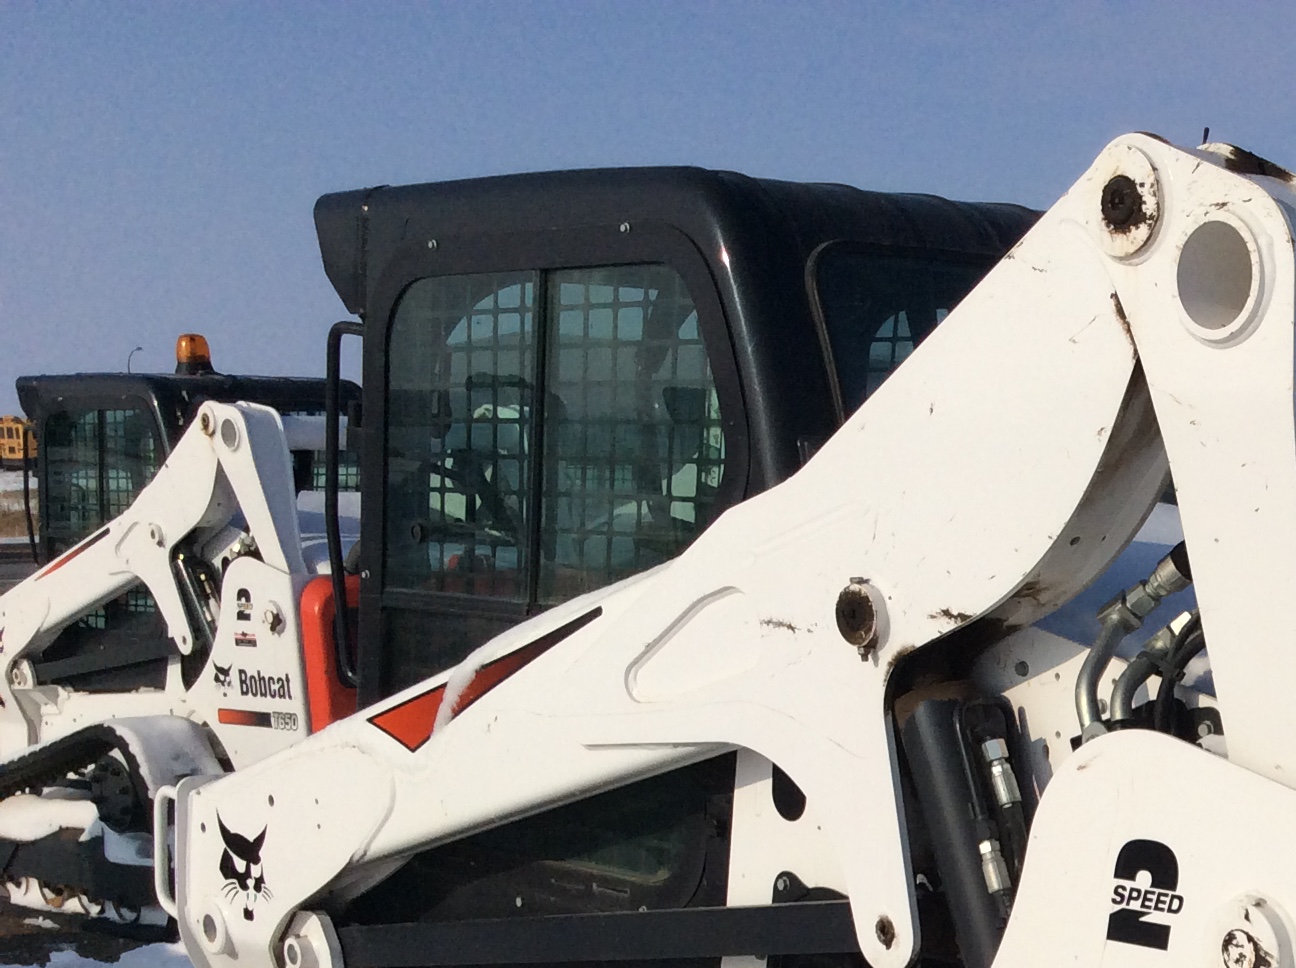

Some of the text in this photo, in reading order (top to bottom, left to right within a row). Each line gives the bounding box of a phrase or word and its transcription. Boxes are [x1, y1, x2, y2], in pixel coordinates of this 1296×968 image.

[238, 668, 292, 700] Bobcat
[272, 711, 299, 731] T650
[1106, 839, 1179, 951] 2
[1110, 884, 1184, 915] SPEED
